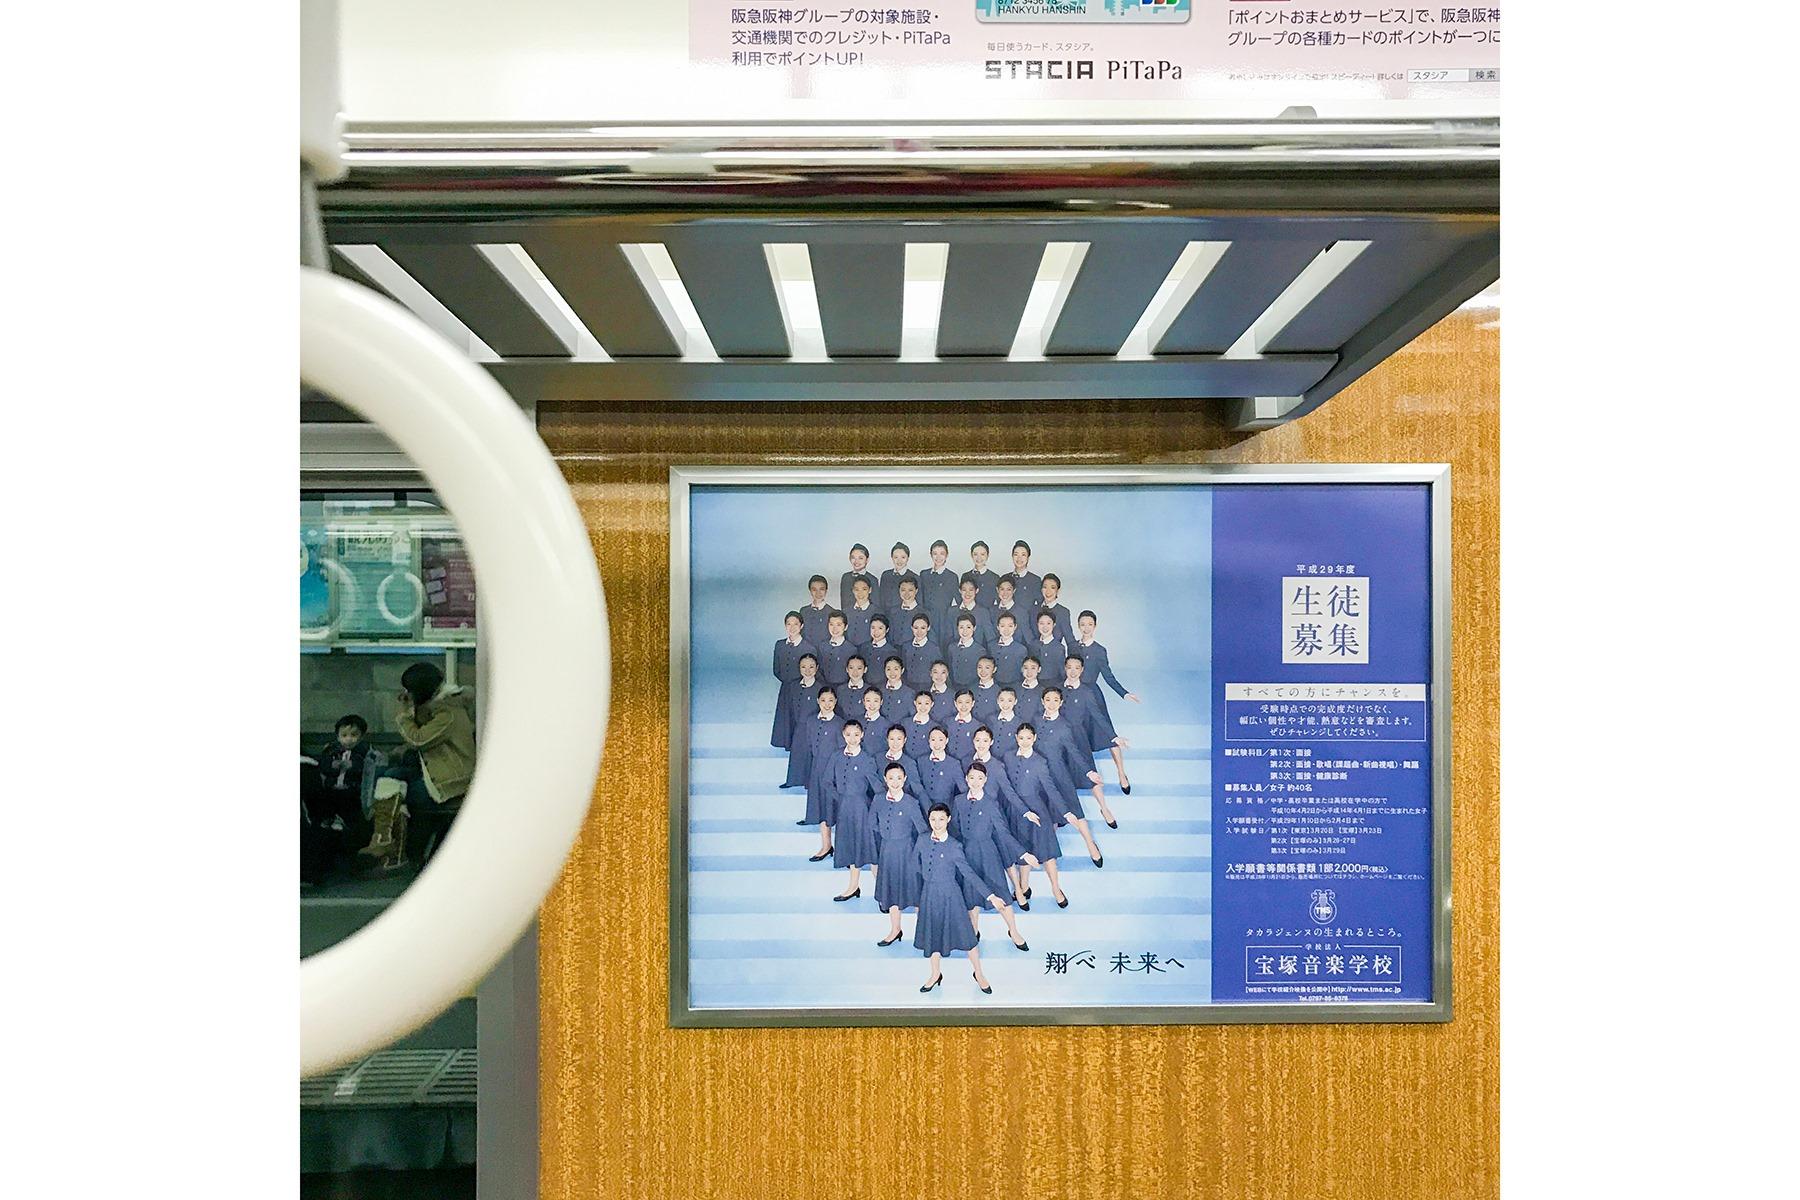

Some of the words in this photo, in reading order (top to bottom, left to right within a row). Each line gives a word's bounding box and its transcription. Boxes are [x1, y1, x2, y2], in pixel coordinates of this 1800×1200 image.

[998, 6, 1039, 14] HANKYU
[1042, 5, 1086, 14] HANSHIN
[731, 9, 939, 24] 阪急阪神グループの対象施設・
[731, 30, 951, 46] 交通機関でのクレジット・PiTaPa
[987, 42, 1094, 53] 毎日使うカード、スタシア。
[731, 51, 864, 67] 利用でポイントUP!
[985, 60, 1094, 80] STACIA
[1107, 60, 1182, 80] PiTaPa
[1413, 70, 1449, 81] スタシア
[1475, 69, 1496, 80] 検索
[1297, 565, 1356, 574] 平成29年度
[1291, 584, 1361, 618] 生徒
[1291, 623, 1360, 657] 募集
[1243, 687, 1409, 698] すべての方にチャンスを。
[1260, 704, 1393, 714] 受験時点での完成度だけでなく、
[1245, 927, 1403, 938] タカラジェンヌの生まれるところ。
[1043, 950, 1096, 975] 翔べ
[1109, 951, 1185, 974] 未来へ
[1254, 954, 1393, 976] 宝塚音楽学校
